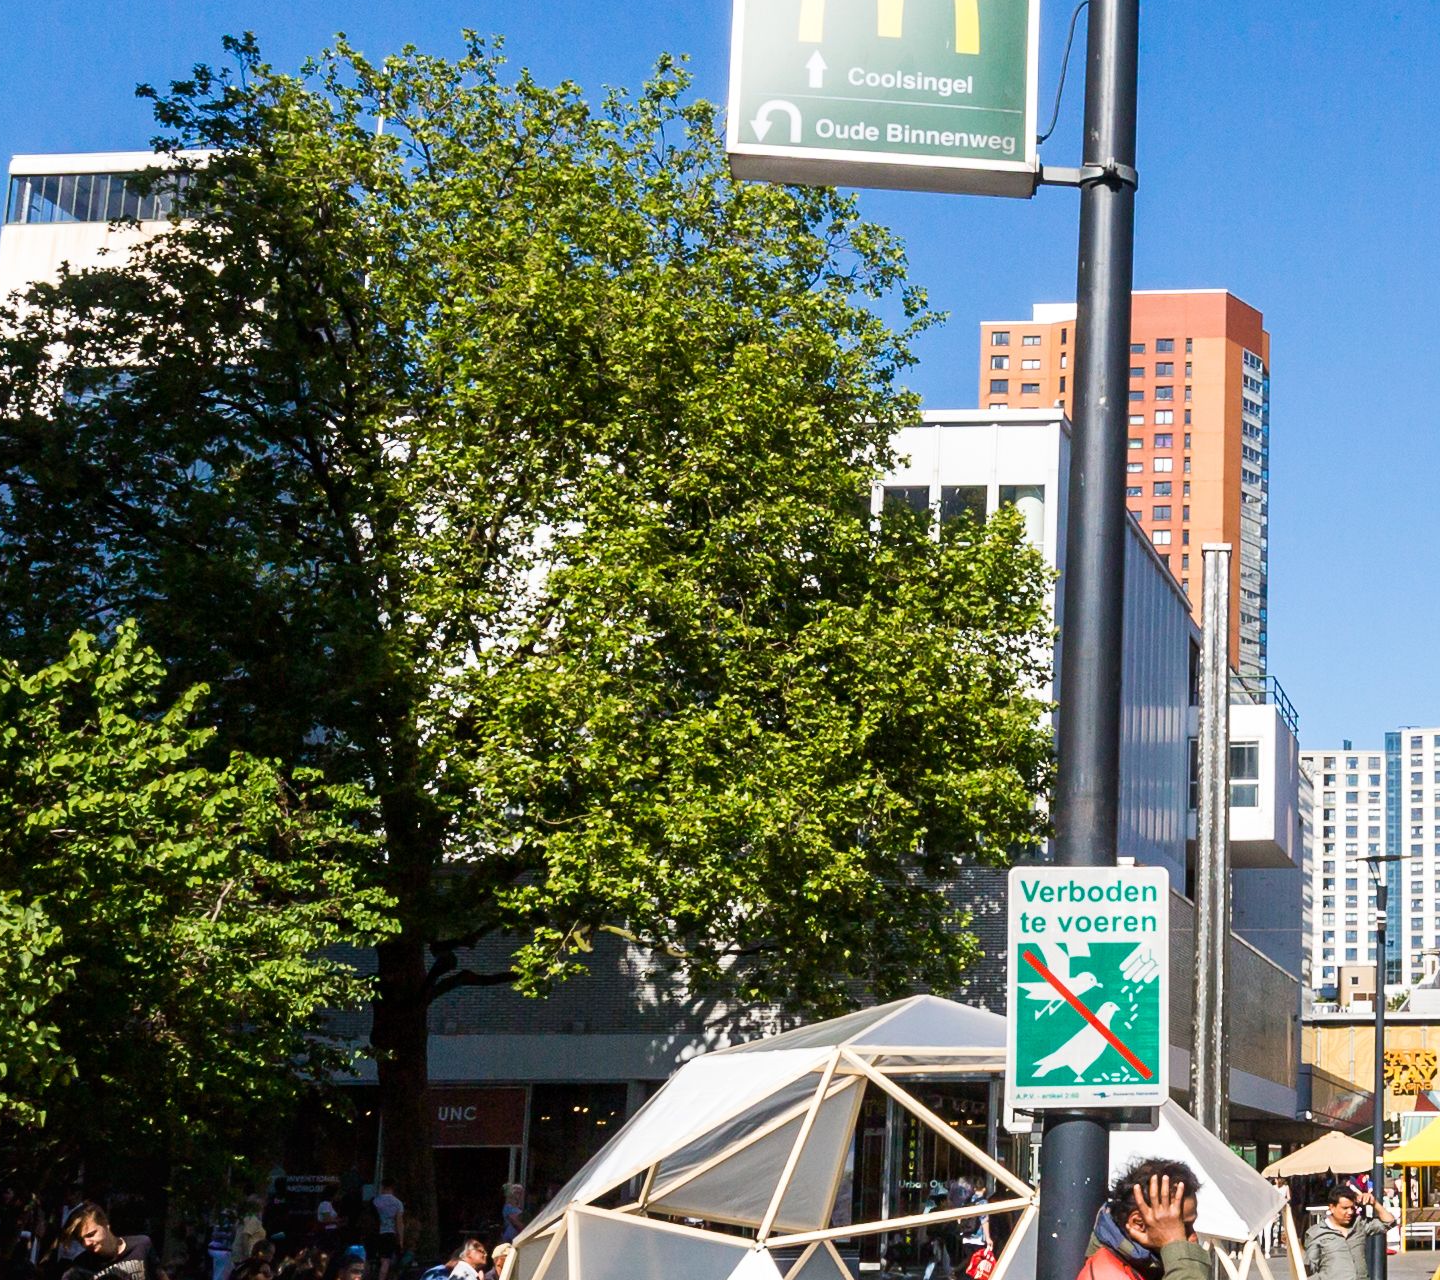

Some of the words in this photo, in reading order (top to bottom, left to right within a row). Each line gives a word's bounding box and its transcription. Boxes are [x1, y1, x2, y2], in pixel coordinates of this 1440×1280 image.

[848, 67, 973, 96] Coolsingel
[815, 118, 879, 143] Oude
[886, 122, 1017, 155] Binnenweg
[1020, 880, 1158, 903] Verboden
[1020, 912, 1047, 933] te
[1057, 914, 1157, 933] voeren
[437, 1105, 478, 1121] UNC
